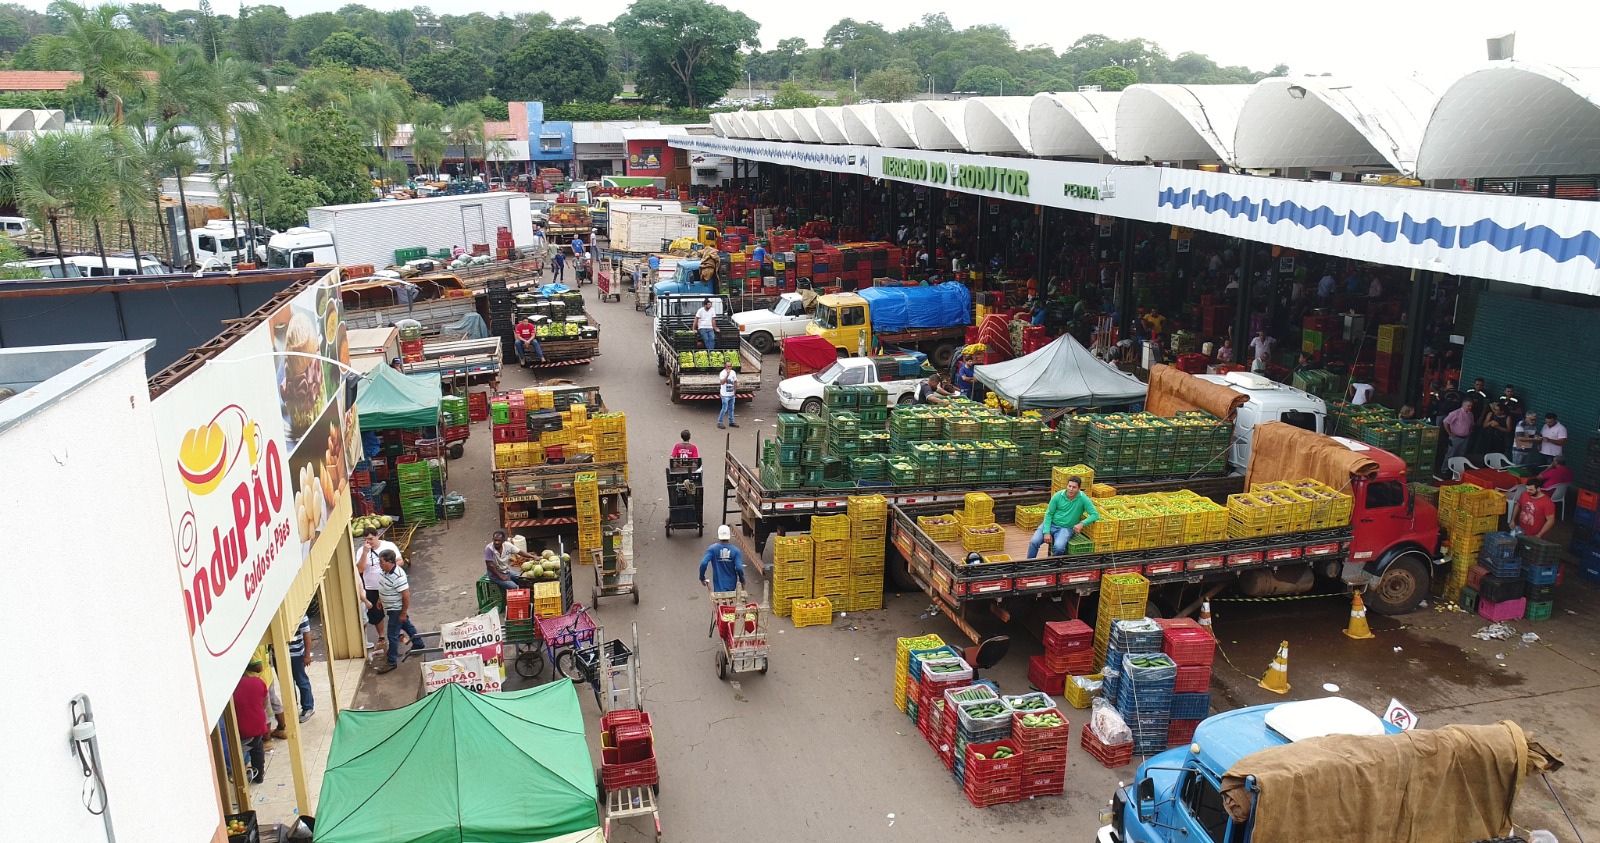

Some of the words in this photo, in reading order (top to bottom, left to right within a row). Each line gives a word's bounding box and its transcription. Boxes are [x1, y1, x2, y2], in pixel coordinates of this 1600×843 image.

[882, 156, 927, 181] MERCADO
[930, 162, 947, 184] DO
[1064, 183, 1099, 201] PEDRA
[244, 549, 271, 602] Caldos
[274, 518, 290, 555] Pães
[445, 633, 493, 650] PROMOÇÃO
